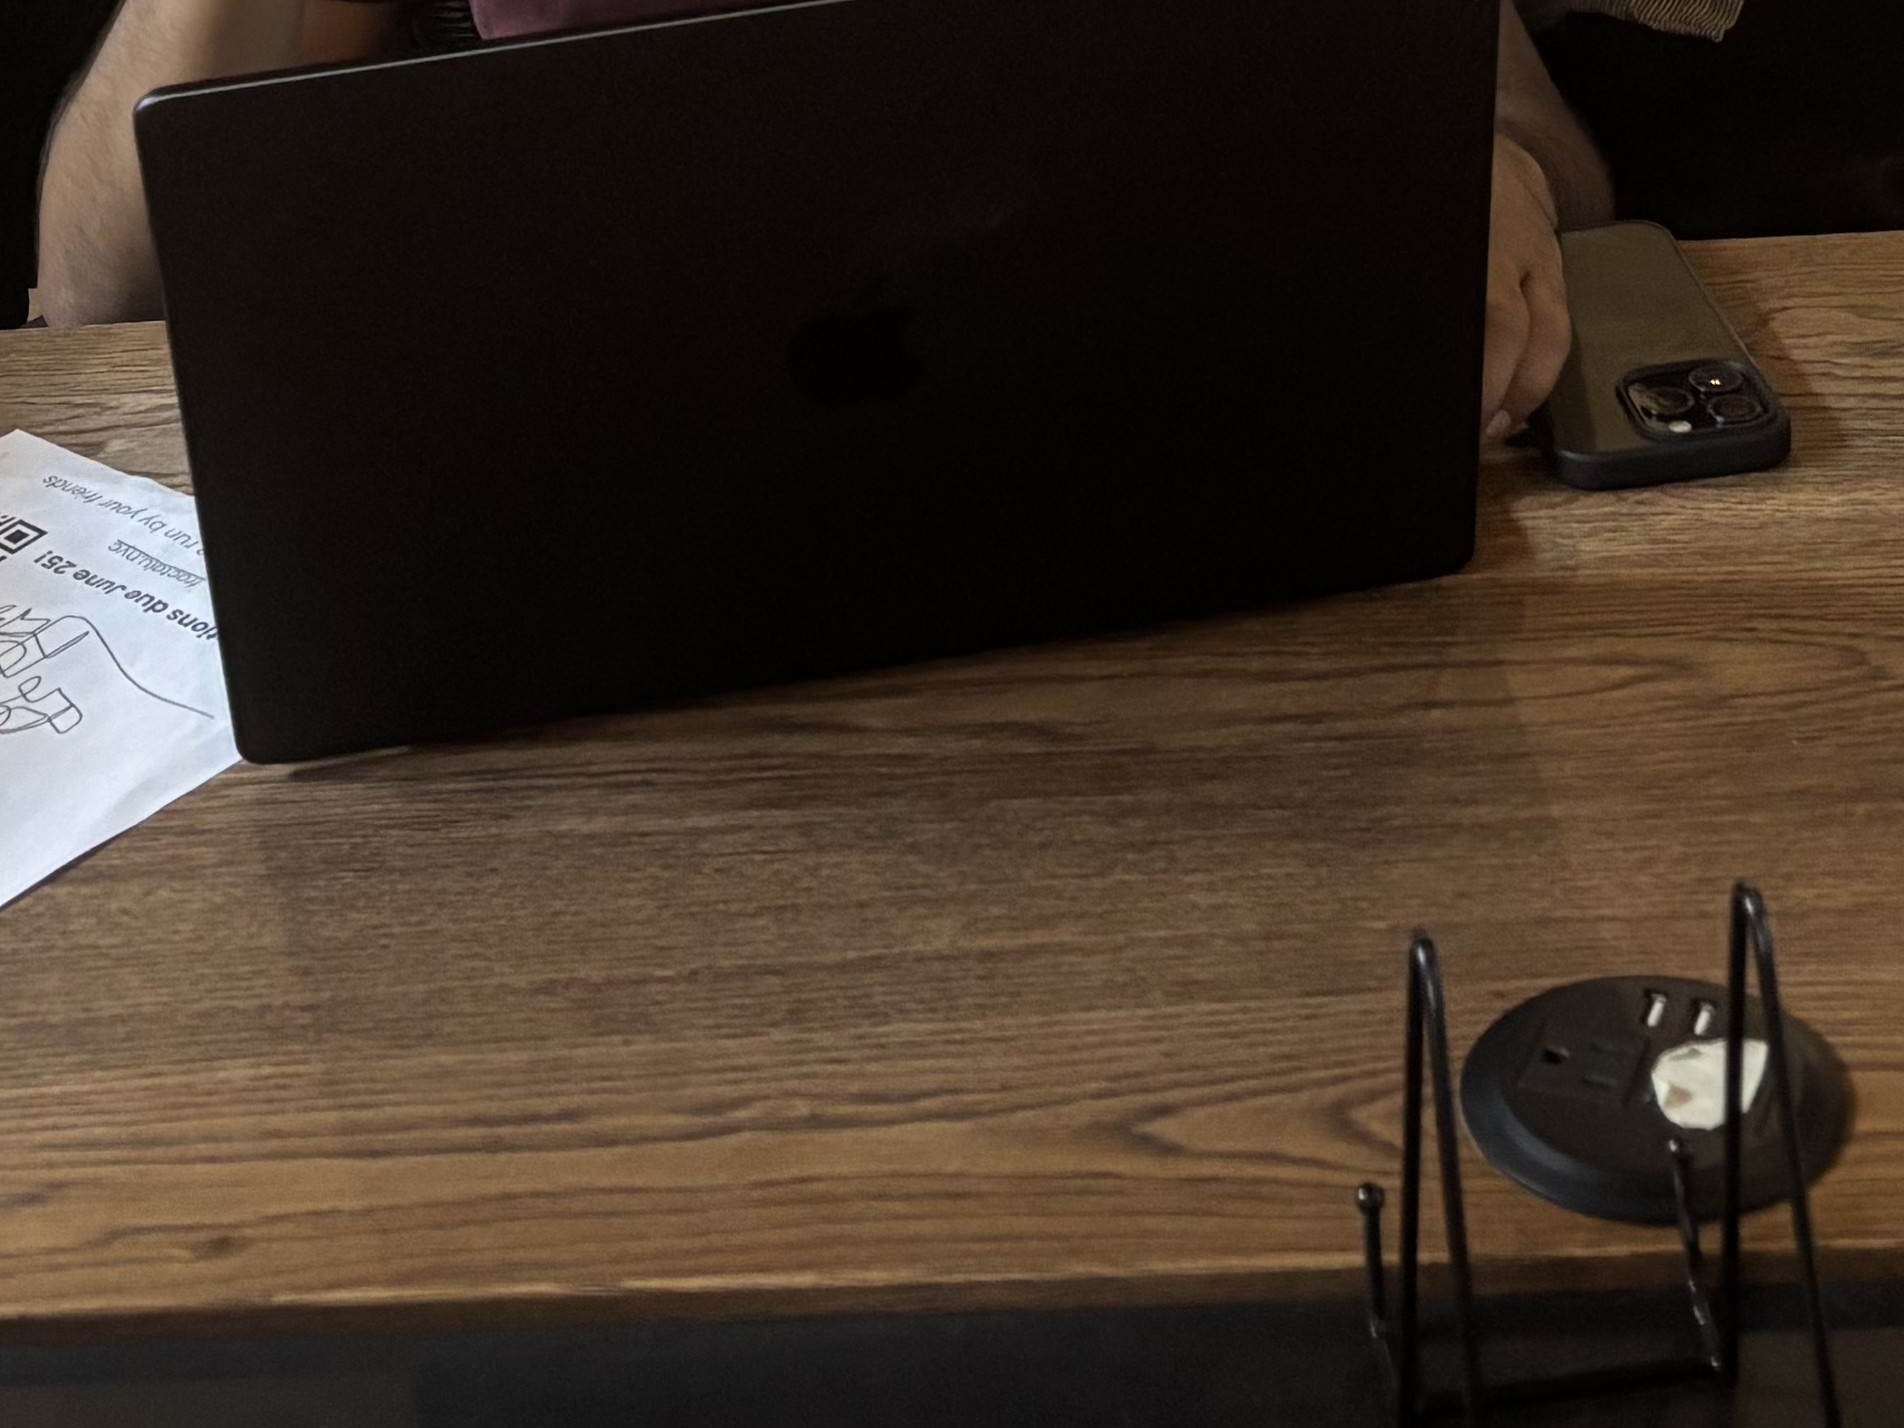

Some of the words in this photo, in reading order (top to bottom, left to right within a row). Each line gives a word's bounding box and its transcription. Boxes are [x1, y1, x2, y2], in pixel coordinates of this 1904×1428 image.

[43, 474, 102, 504] friends
[98, 497, 146, 520] your
[139, 514, 167, 534] by
[164, 527, 199, 549] run
[34, 550, 78, 576] 25!
[73, 568, 127, 595] June
[124, 590, 169, 614] due
